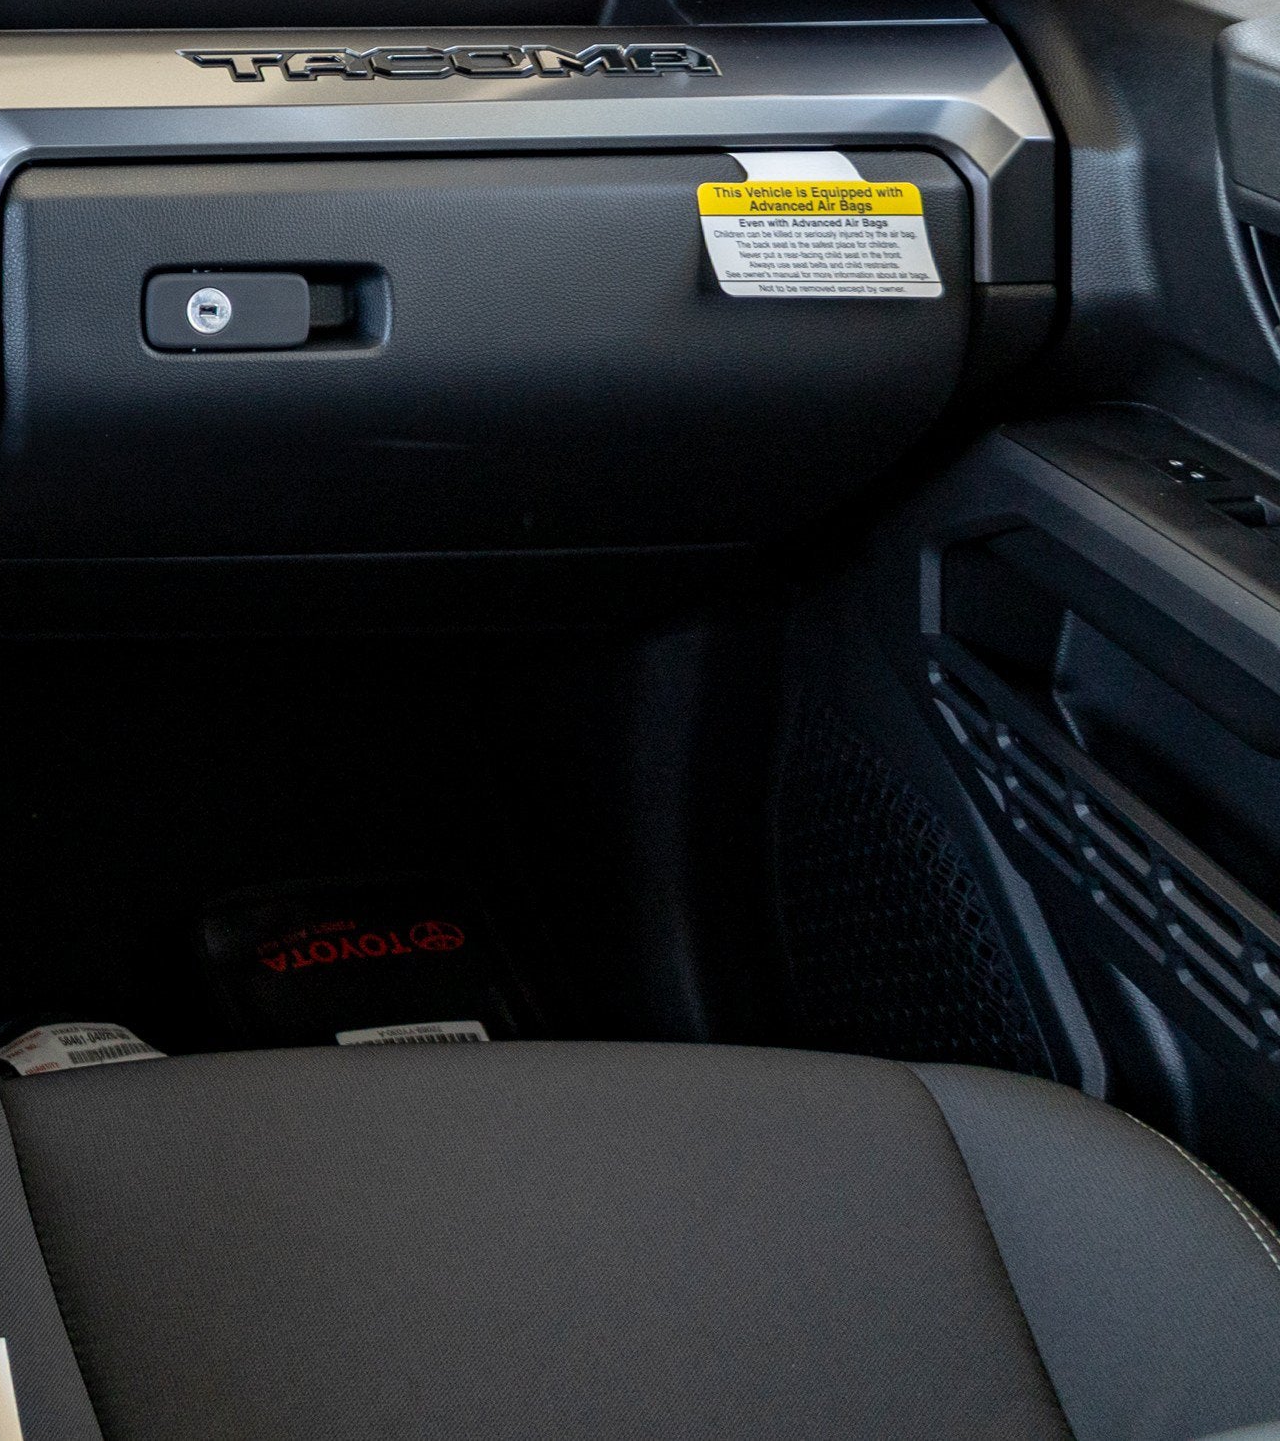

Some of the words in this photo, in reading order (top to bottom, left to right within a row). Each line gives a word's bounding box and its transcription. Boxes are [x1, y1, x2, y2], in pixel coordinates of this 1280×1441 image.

[174, 43, 724, 83] TACOMA
[713, 187, 742, 198] This
[745, 187, 793, 198] Vehicle
[795, 187, 808, 198] is
[811, 186, 873, 200] Equipped
[875, 187, 903, 198] with
[749, 200, 814, 212] Advanced
[817, 200, 836, 211] Air
[839, 200, 873, 214] Bags
[739, 218, 765, 228] Even
[767, 218, 789, 228] with
[791, 218, 842, 227] Advanced
[844, 219, 860, 227] Air
[861, 218, 888, 230] Bags
[758, 284, 775, 292] Not
[799, 285, 836, 293] removed
[838, 285, 865, 293] except
[866, 285, 877, 294] by
[258, 931, 413, 973] TOYOTA
